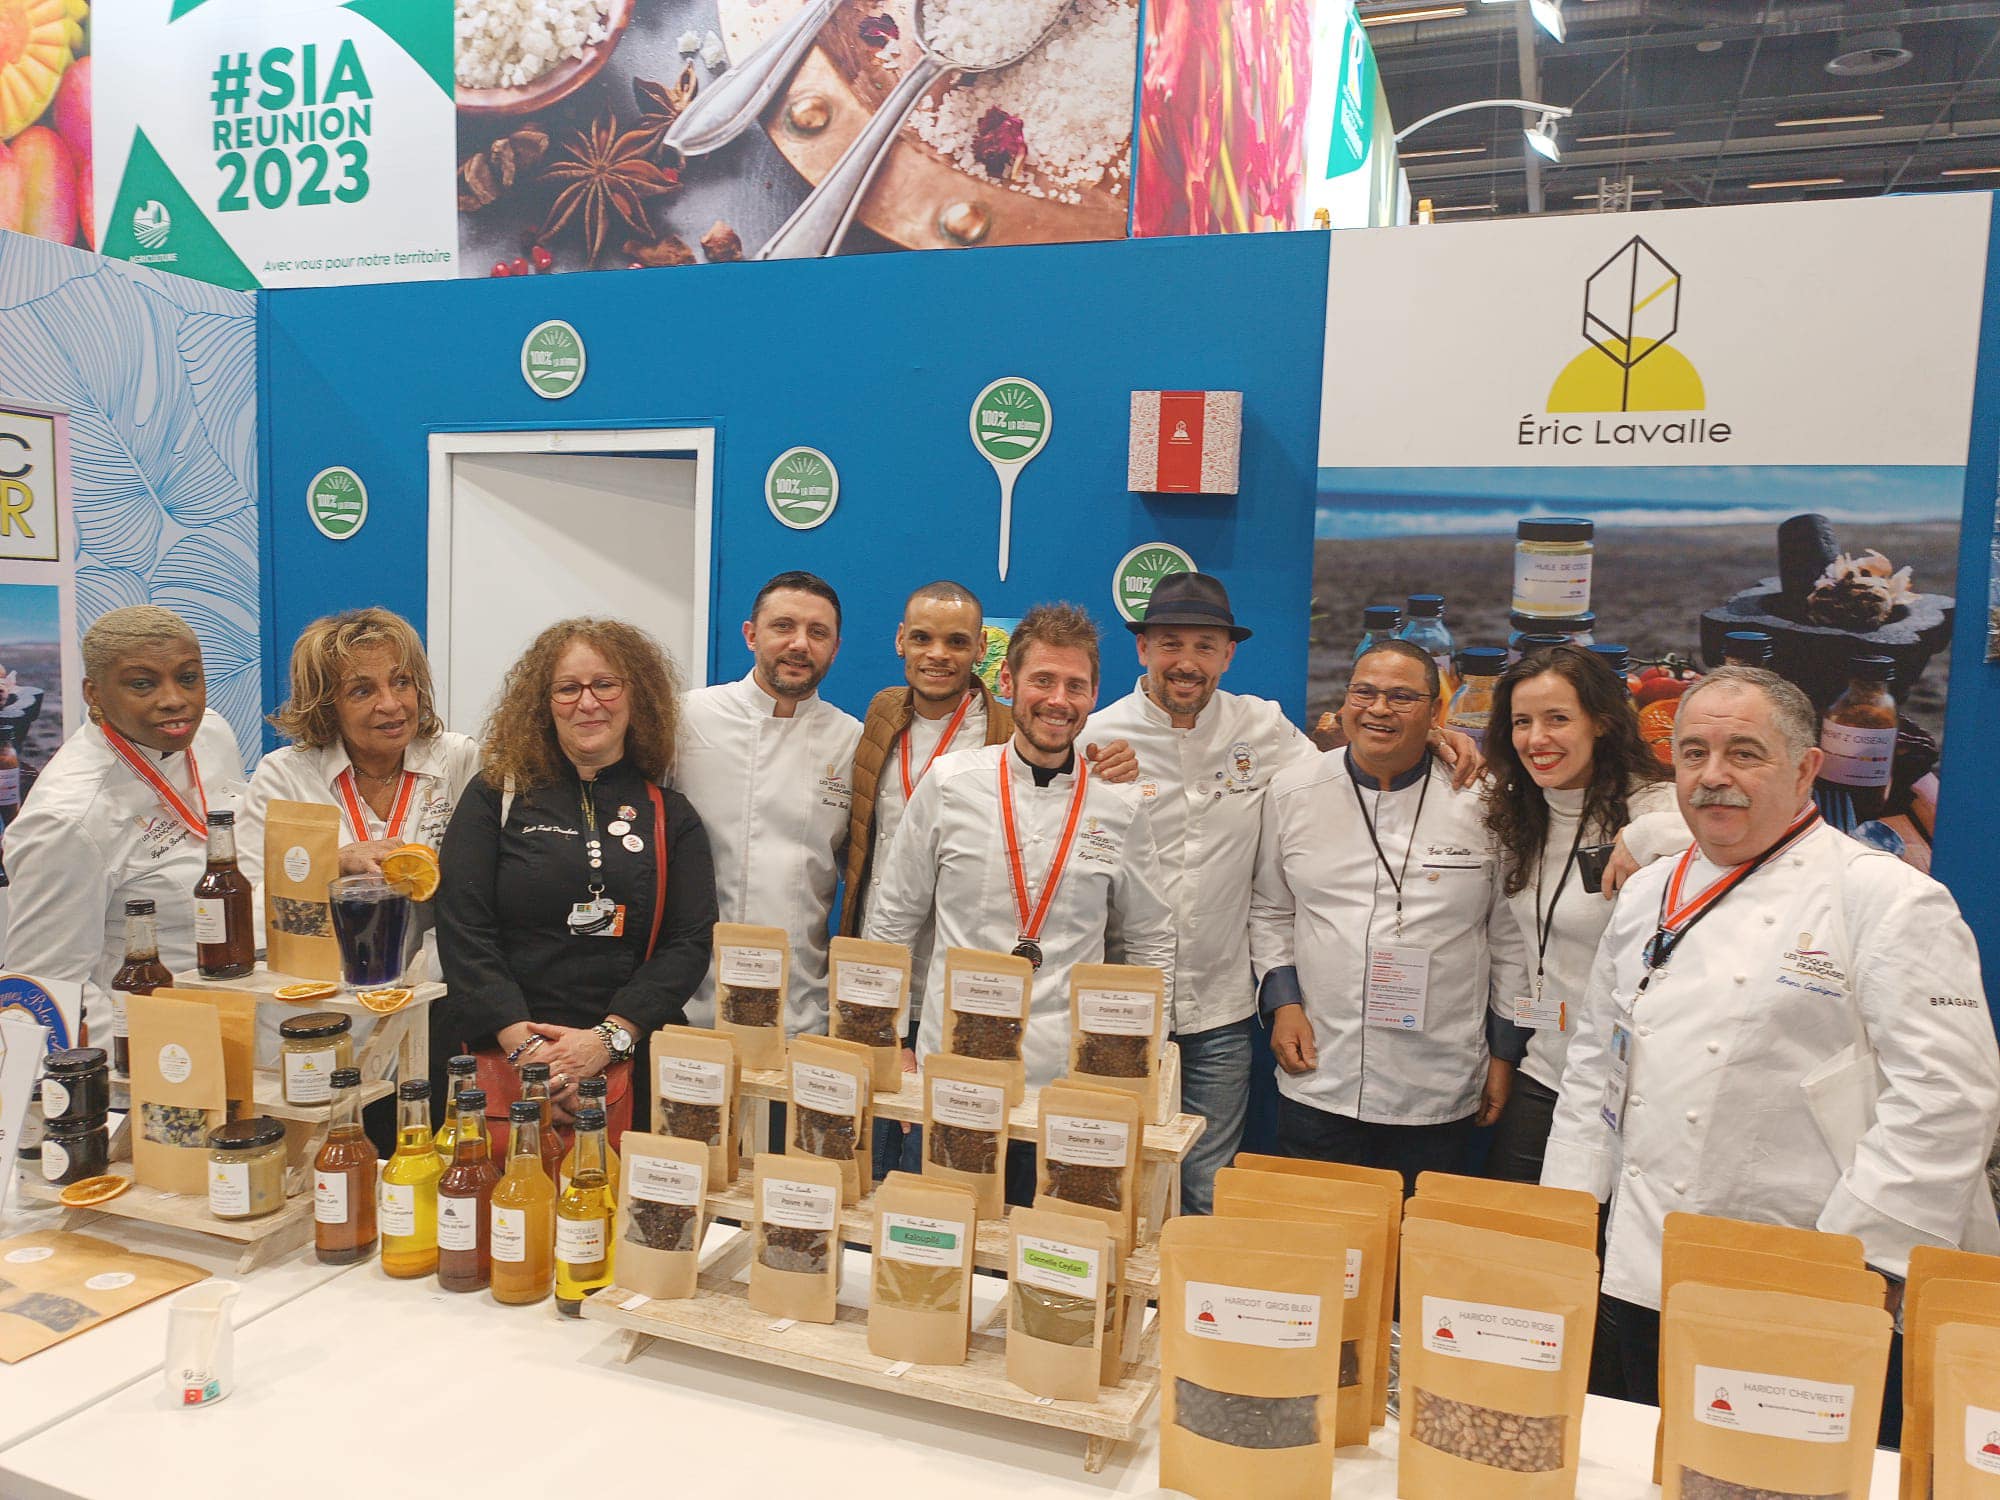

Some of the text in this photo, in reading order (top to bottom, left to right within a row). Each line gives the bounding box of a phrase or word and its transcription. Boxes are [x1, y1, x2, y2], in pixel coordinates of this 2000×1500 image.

[211, 39, 374, 116] #SIA
[213, 104, 371, 150] REUNION
[216, 140, 370, 212] 2023
[263, 248, 451, 274] Avec vous pour notre territoire
[981, 409, 1008, 428] 100%
[1518, 413, 1732, 445] Éric Lavalle
[776, 478, 801, 495] 100%
[1125, 576, 1154, 593] 100%
[1930, 996, 1979, 1009] BRAGARD
[1224, 1296, 1262, 1308] HARICOT
[1265, 1301, 1290, 1312] GROS
[1459, 1311, 1555, 1333] HARICOT COCO ROSE
[1743, 1382, 1846, 1404] HARICOT CHEVRETTE
